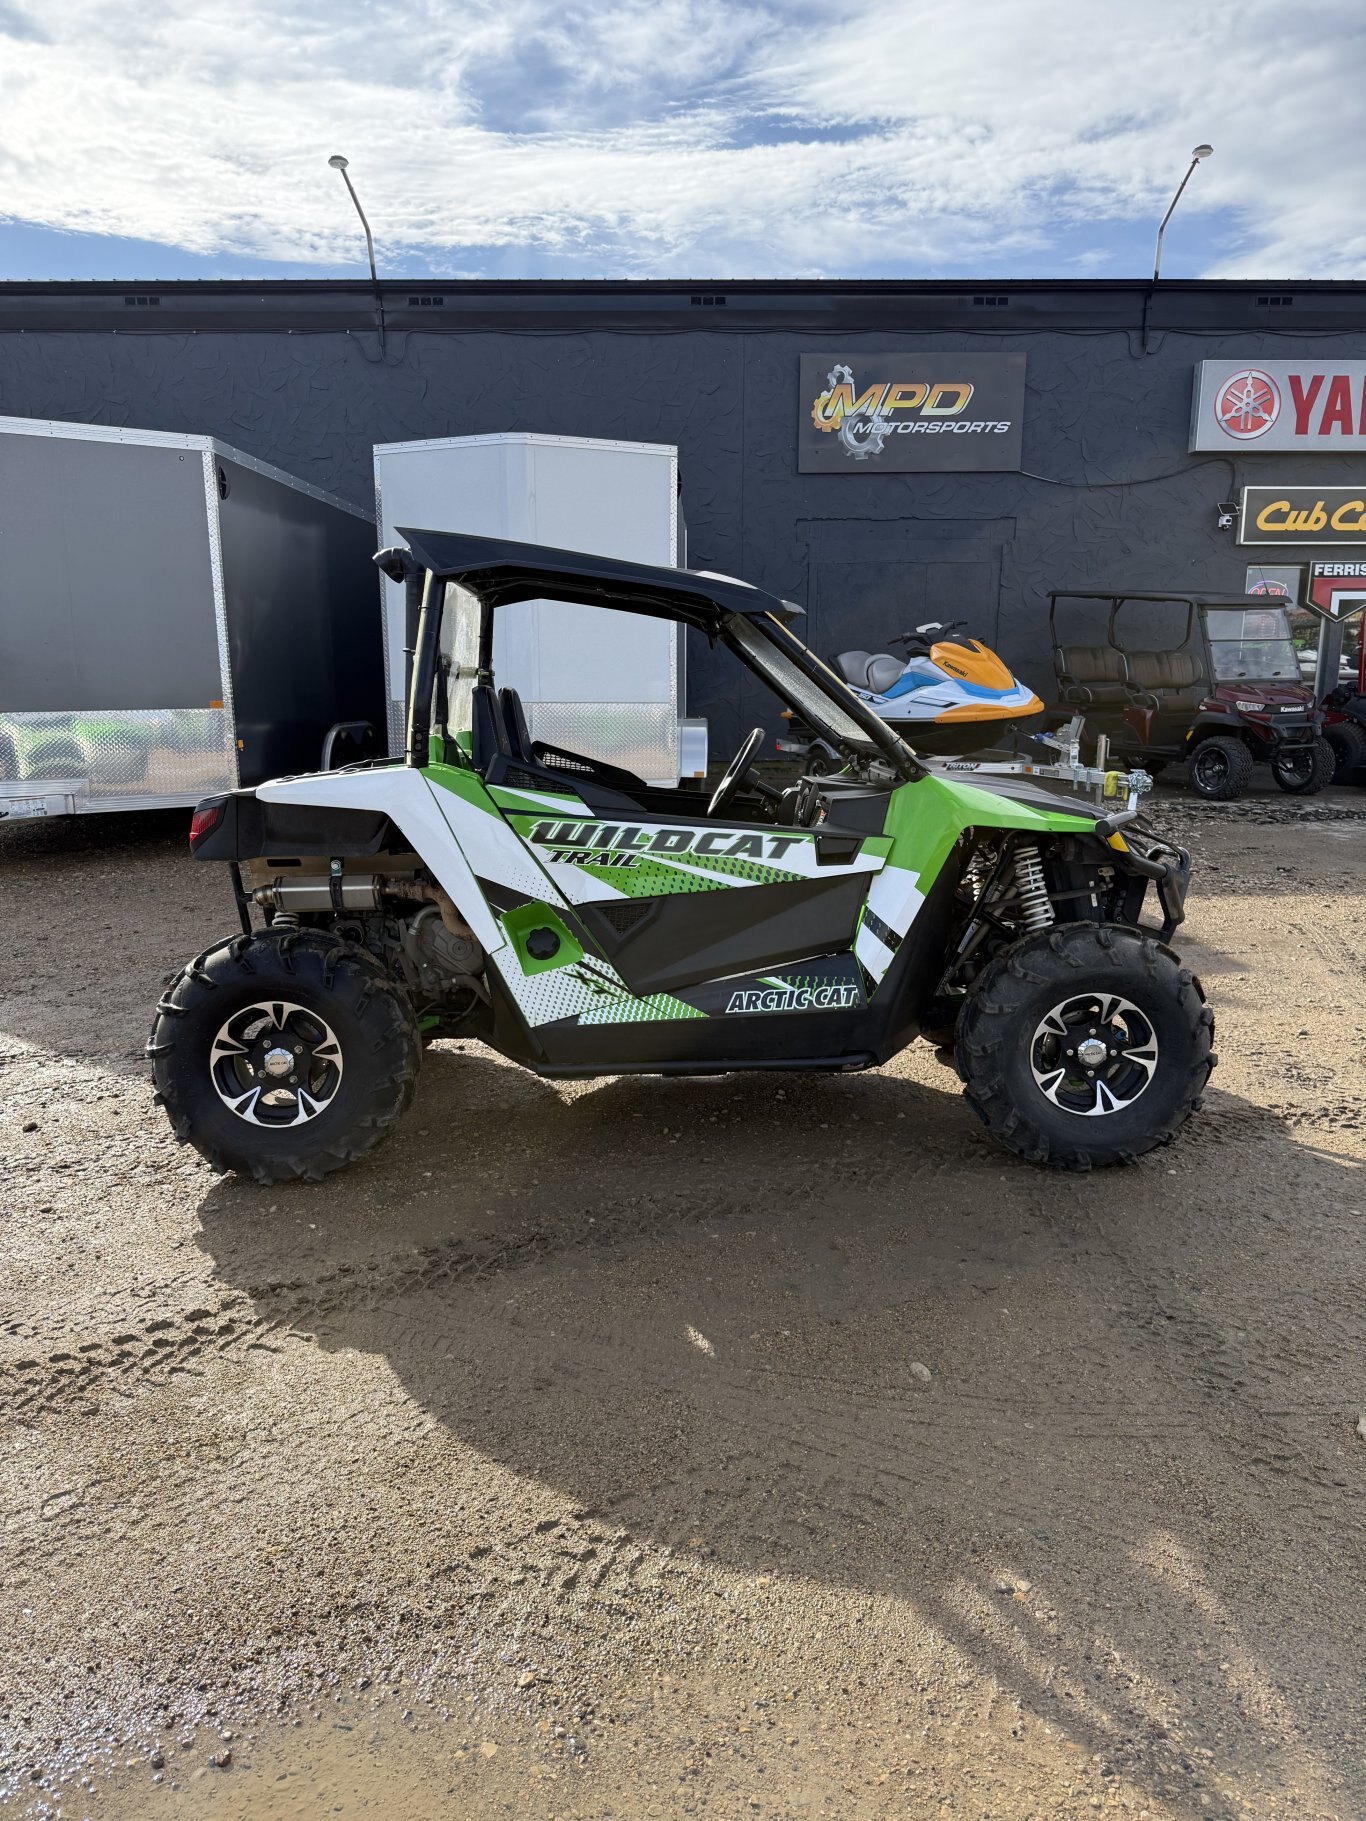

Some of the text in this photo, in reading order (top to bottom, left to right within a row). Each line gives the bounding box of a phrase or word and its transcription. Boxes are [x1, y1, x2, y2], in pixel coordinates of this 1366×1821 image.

[824, 383, 974, 416] MPD
[853, 421, 1011, 434] MOTORSPORTS
[1256, 501, 1327, 531] Cub
[943, 660, 969, 677] Kawasaki
[529, 820, 811, 859] WILDCAT
[544, 849, 641, 868] TRAIL
[725, 985, 857, 1013] ARCTIC CAT
